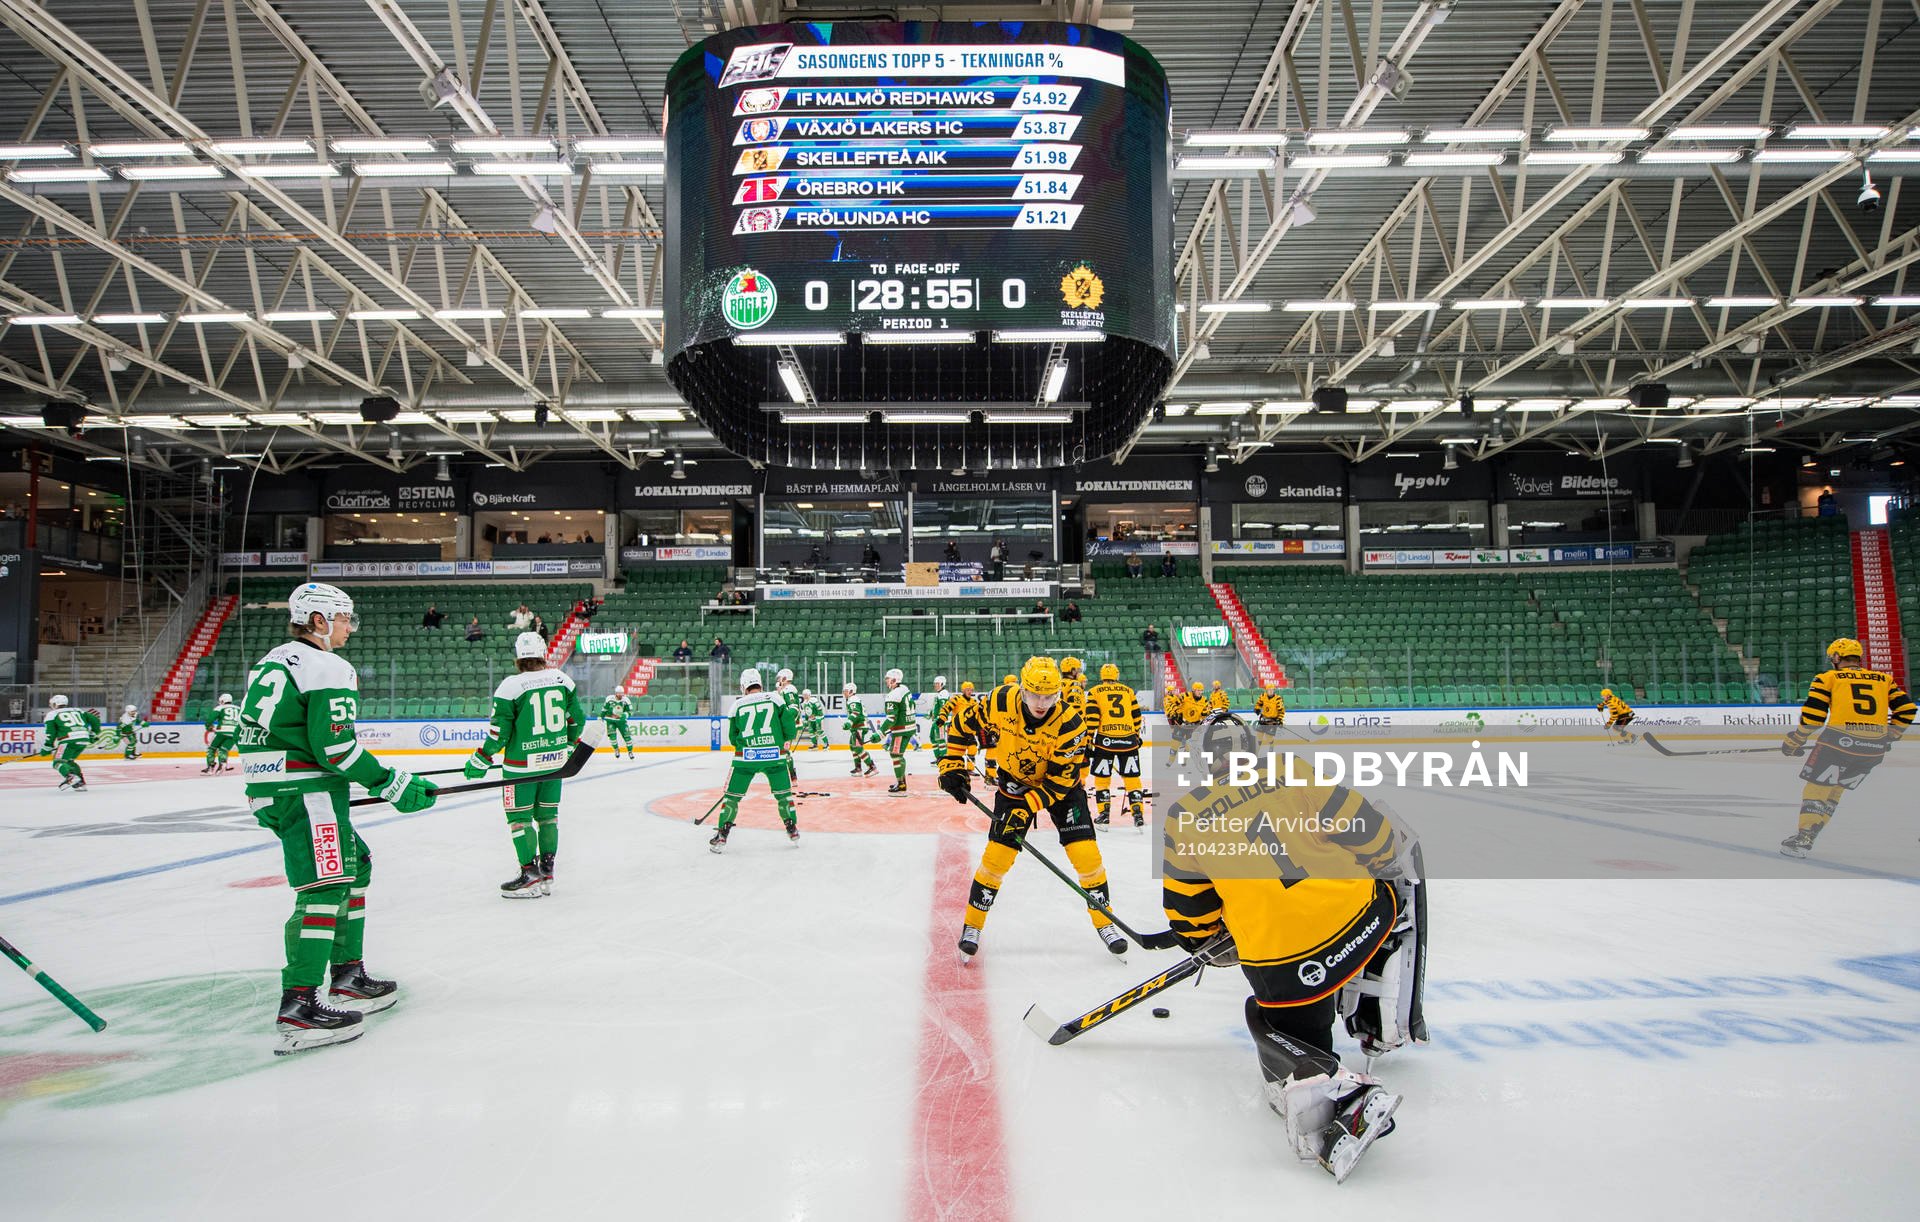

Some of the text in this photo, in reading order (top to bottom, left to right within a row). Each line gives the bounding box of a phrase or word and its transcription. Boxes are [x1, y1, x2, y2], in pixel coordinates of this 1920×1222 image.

[798, 53, 887, 69] SASONGENS
[892, 53, 931, 68] TOPP
[935, 53, 945, 68] 5
[961, 52, 1044, 68] TEKNINGAR
[1049, 52, 1064, 68] %
[796, 89, 995, 106] IF MALMÖ REDHAWKS
[1022, 92, 1067, 105] 54.92
[796, 118, 963, 135] VÄXJÖ LAKERS HC
[1023, 122, 1067, 134] 53.87
[796, 149, 947, 165] SKELLEFTEÅ AIK
[1024, 151, 1067, 164] 51.98
[796, 179, 905, 195] ÖREBRO HK
[1024, 181, 1068, 194] 51.84
[796, 209, 930, 225] FRÖLUNDA HC
[1026, 210, 1067, 224] 51.21
[870, 263, 960, 275] TO FACE-OFF
[804, 280, 828, 310] 0
[857, 279, 973, 310] 28:55
[1002, 278, 1026, 309] 0
[730, 294, 768, 323] RÖGLE
[883, 318, 949, 329] PERIOD 1
[1062, 318, 1104, 328] AIK HOCKEY
[815, 483, 829, 493] PÅ
[830, 484, 899, 493] HEMMAPLAN
[938, 482, 1000, 491] ÄNGELHOLM
[1002, 482, 1033, 491] LÄSER
[1035, 483, 1047, 491] VI
[1076, 480, 1193, 491] LOKALTIDNINGEN
[1561, 476, 1618, 489] Bildeve
[412, 486, 455, 499] STENA
[635, 485, 752, 496] LOKALTIDNINGEN
[399, 500, 456, 509] RECYCLING
[489, 493, 536, 504] Bjäre Kraft
[658, 549, 673, 559] LM
[1365, 553, 1378, 562] LM
[1837, 673, 1887, 682] BOLIDEN
[1107, 694, 1125, 718] 3
[1850, 683, 1877, 715] 5
[224, 707, 239, 721] 91
[329, 696, 357, 722] 53
[529, 689, 565, 736] 16
[57, 711, 85, 727] 90
[738, 702, 775, 738] 77
[1334, 714, 1391, 728] BJÄRE
[1540, 717, 1602, 727] FOODHILLS
[1722, 714, 1792, 726] Backahill
[136, 731, 180, 745] uez
[442, 729, 489, 741] Lindab
[1063, 764, 1075, 778] 2
[314, 838, 325, 863] BYGG
[321, 826, 339, 872] ER-HO
[1244, 809, 1311, 889] 1
[1324, 914, 1381, 969] Contractor
[1079, 972, 1170, 1030] CCM
[1266, 1031, 1308, 1057] BAUER
